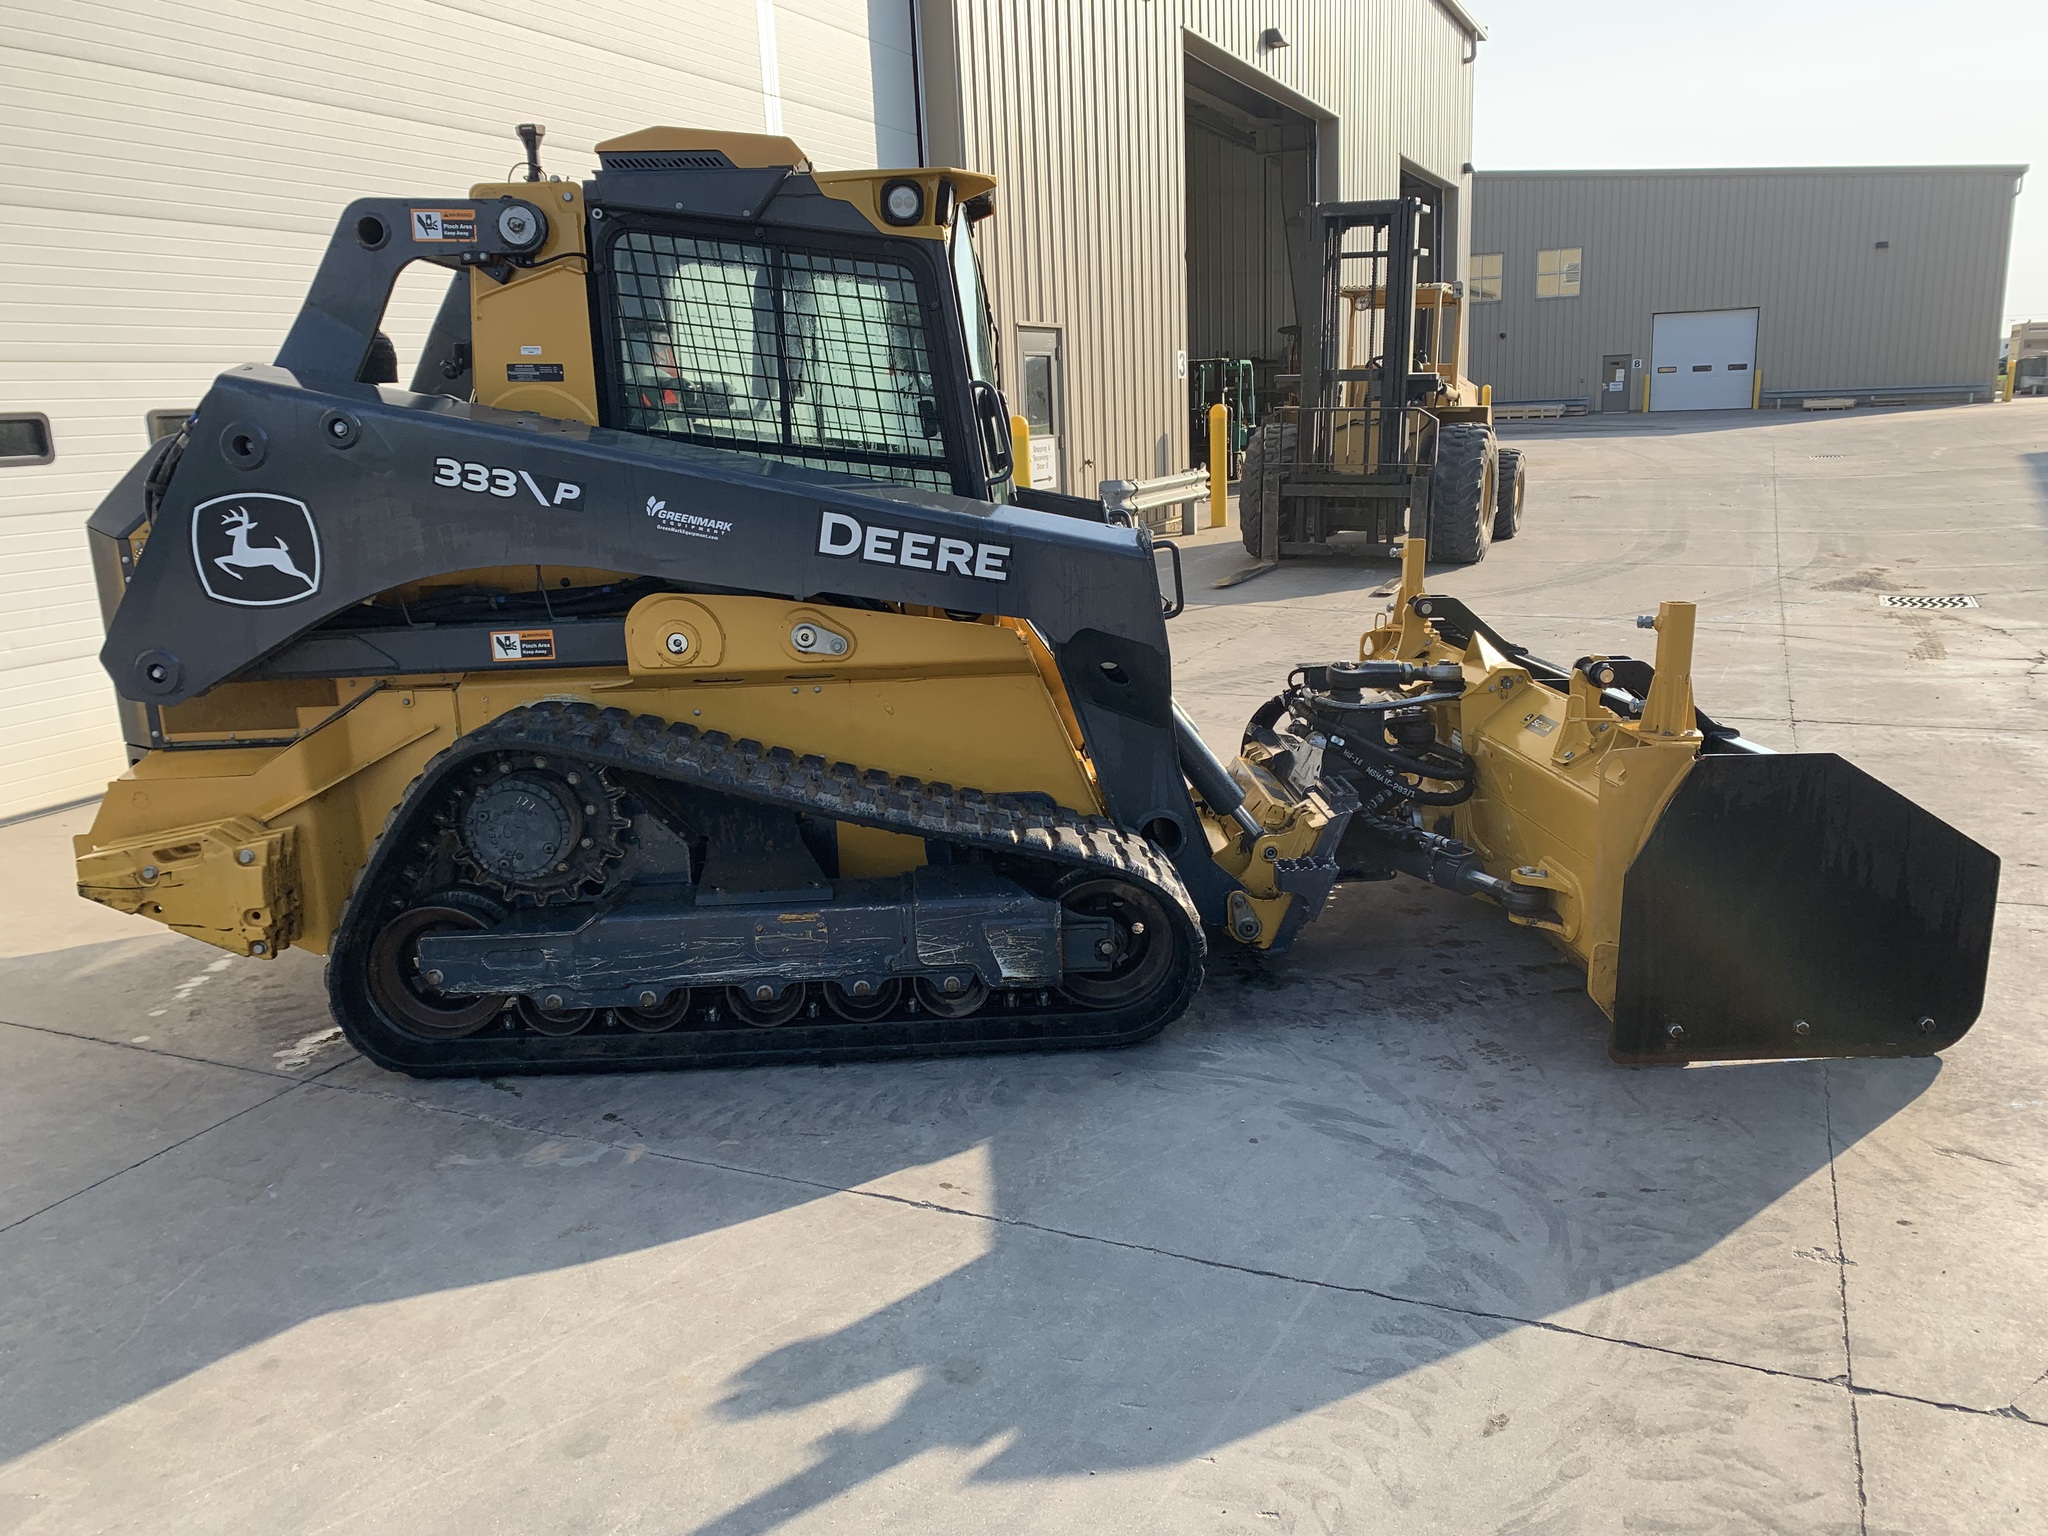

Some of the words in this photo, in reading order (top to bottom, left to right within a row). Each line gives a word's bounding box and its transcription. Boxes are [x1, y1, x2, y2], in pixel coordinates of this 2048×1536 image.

[1179, 352, 1186, 377] 3
[1634, 359, 1641, 368] 8
[657, 509, 733, 532] GREENMARK
[656, 524, 719, 541] GreenMarkEquipment.com
[818, 511, 1011, 581] DEERE
